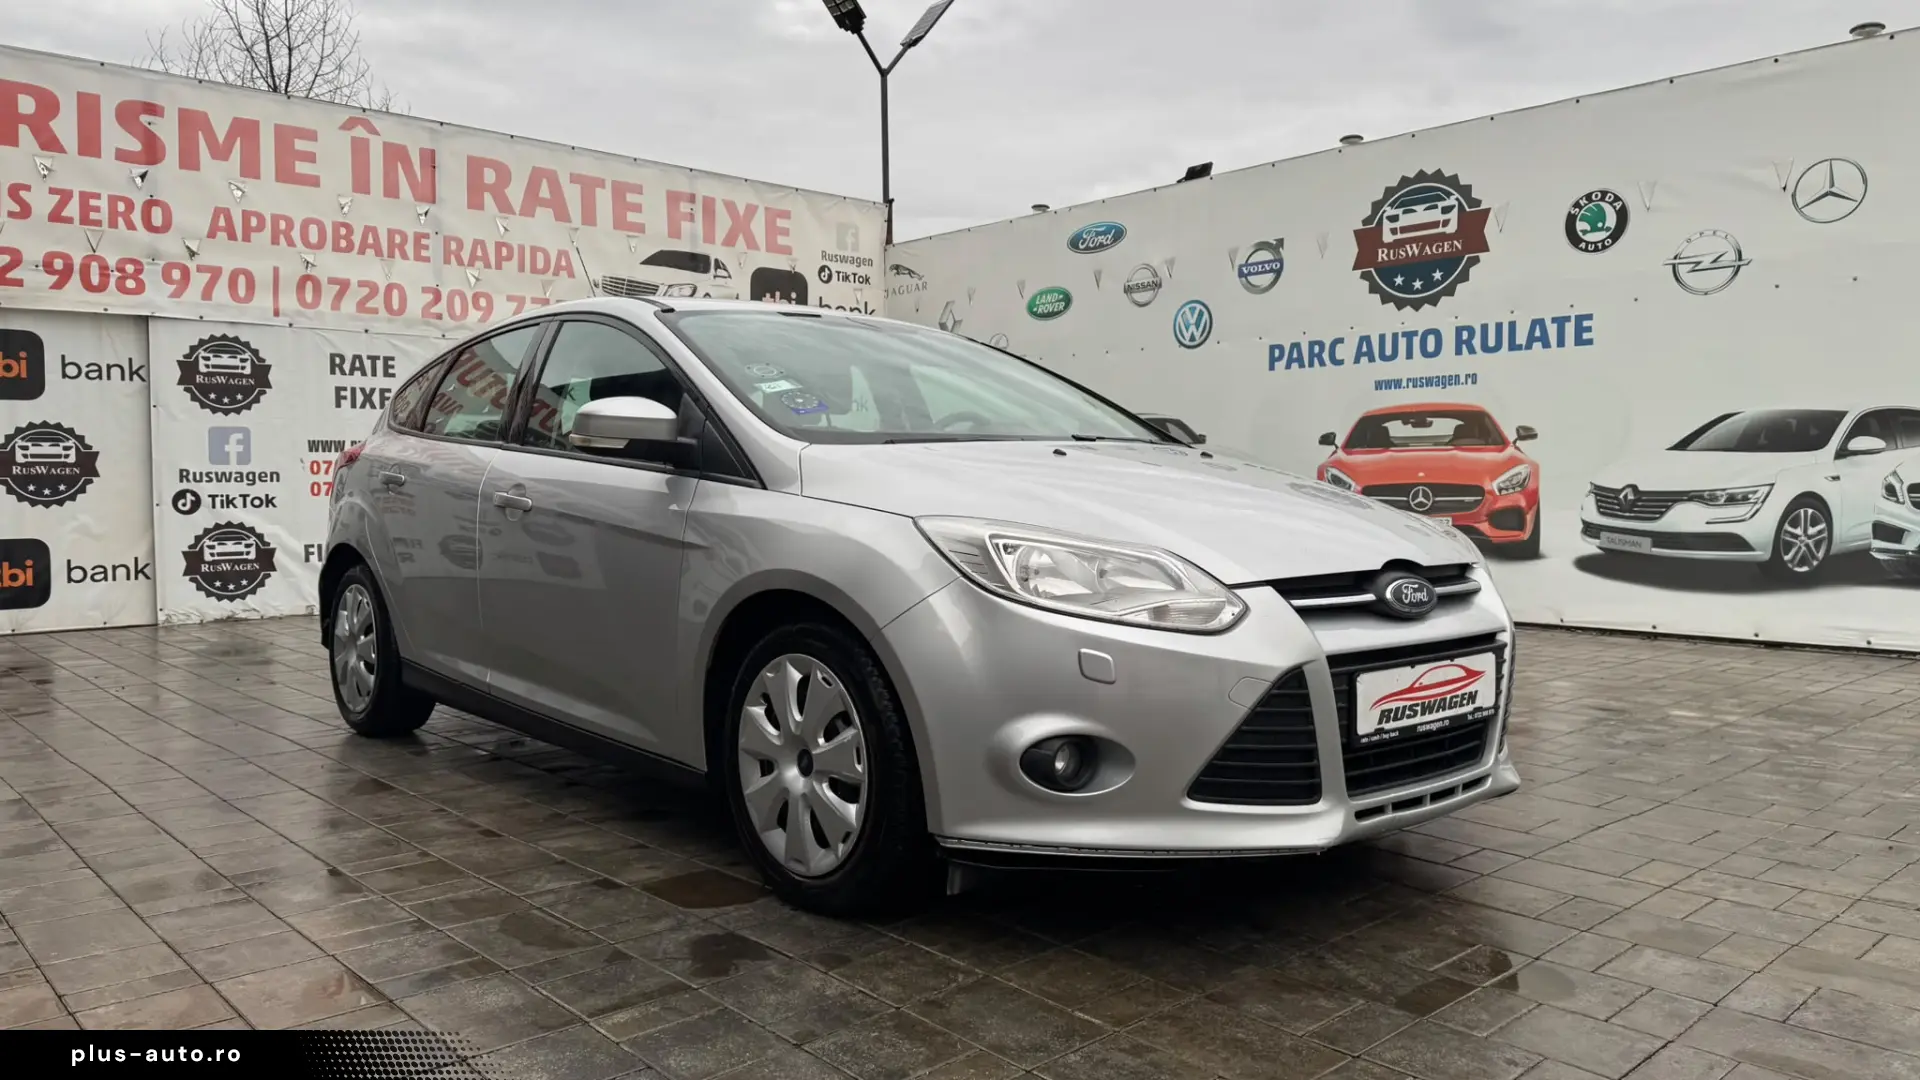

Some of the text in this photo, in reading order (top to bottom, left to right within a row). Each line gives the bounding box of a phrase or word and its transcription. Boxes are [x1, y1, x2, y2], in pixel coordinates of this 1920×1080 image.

[339, 116, 437, 204] ÎN
[466, 155, 646, 234] RATE
[666, 189, 793, 255] FIXE
[48, 187, 173, 234] ZERO
[206, 206, 430, 263] APROBARE
[443, 235, 576, 279] RAPIDA
[1077, 228, 1115, 250] Ford
[1578, 238, 1613, 251] AUTO
[821, 250, 874, 267] Ruswagen
[835, 271, 871, 285] TikTok
[1241, 262, 1281, 275] VOLVO
[42, 250, 146, 296] 908
[161, 262, 256, 304] 970
[295, 274, 408, 317] 0720
[421, 286, 494, 323] 209
[884, 281, 928, 299] JAGUAR
[1126, 279, 1158, 291] NISSAN
[1268, 313, 1594, 371] PARC AUTO RULATE
[61, 354, 147, 382] bank
[329, 353, 396, 378] RATE
[1374, 373, 1477, 391] www.ruswagen.ro
[178, 469, 281, 486] Ruswagen
[208, 494, 277, 509] TikTok
[66, 557, 152, 583] bank
[1401, 583, 1429, 604] Ford
[1377, 690, 1479, 725] RUSWAGEN
[1416, 719, 1449, 733] ruswagen.ro
